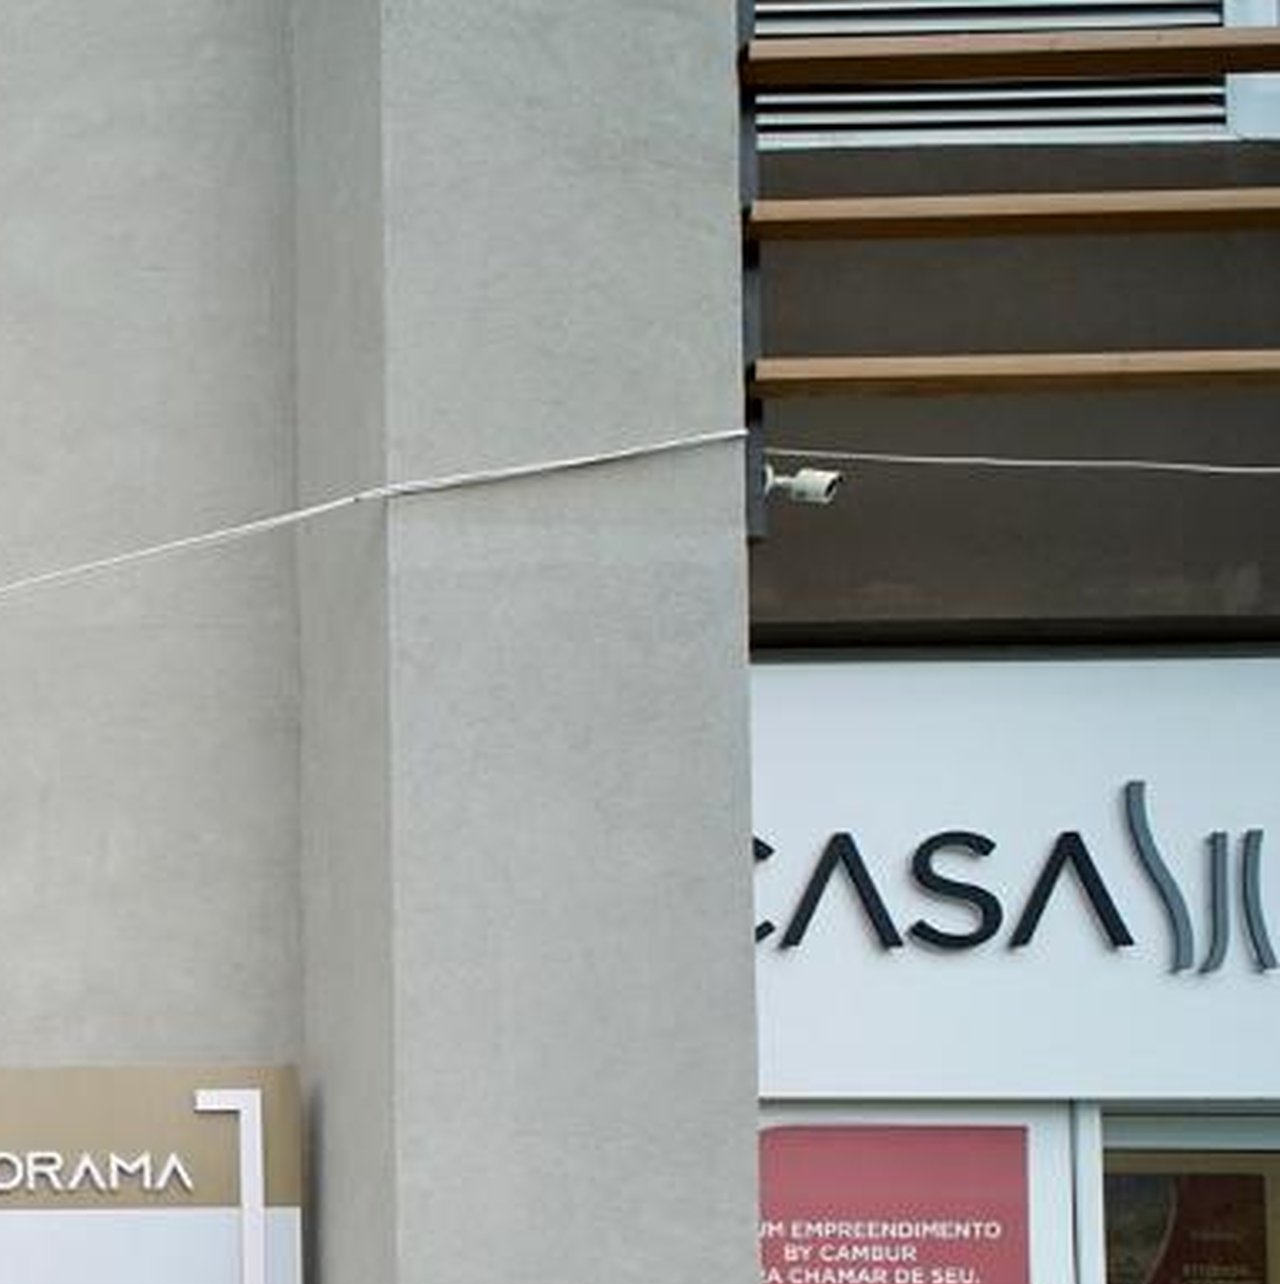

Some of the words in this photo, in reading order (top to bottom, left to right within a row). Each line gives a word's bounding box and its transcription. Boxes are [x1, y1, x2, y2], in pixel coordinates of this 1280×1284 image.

[752, 830, 1136, 953] ASA
[791, 1220, 1003, 1240] EMPREENDIMENTO
[783, 1243, 814, 1262] BY
[819, 1243, 918, 1263] CAMBUR
